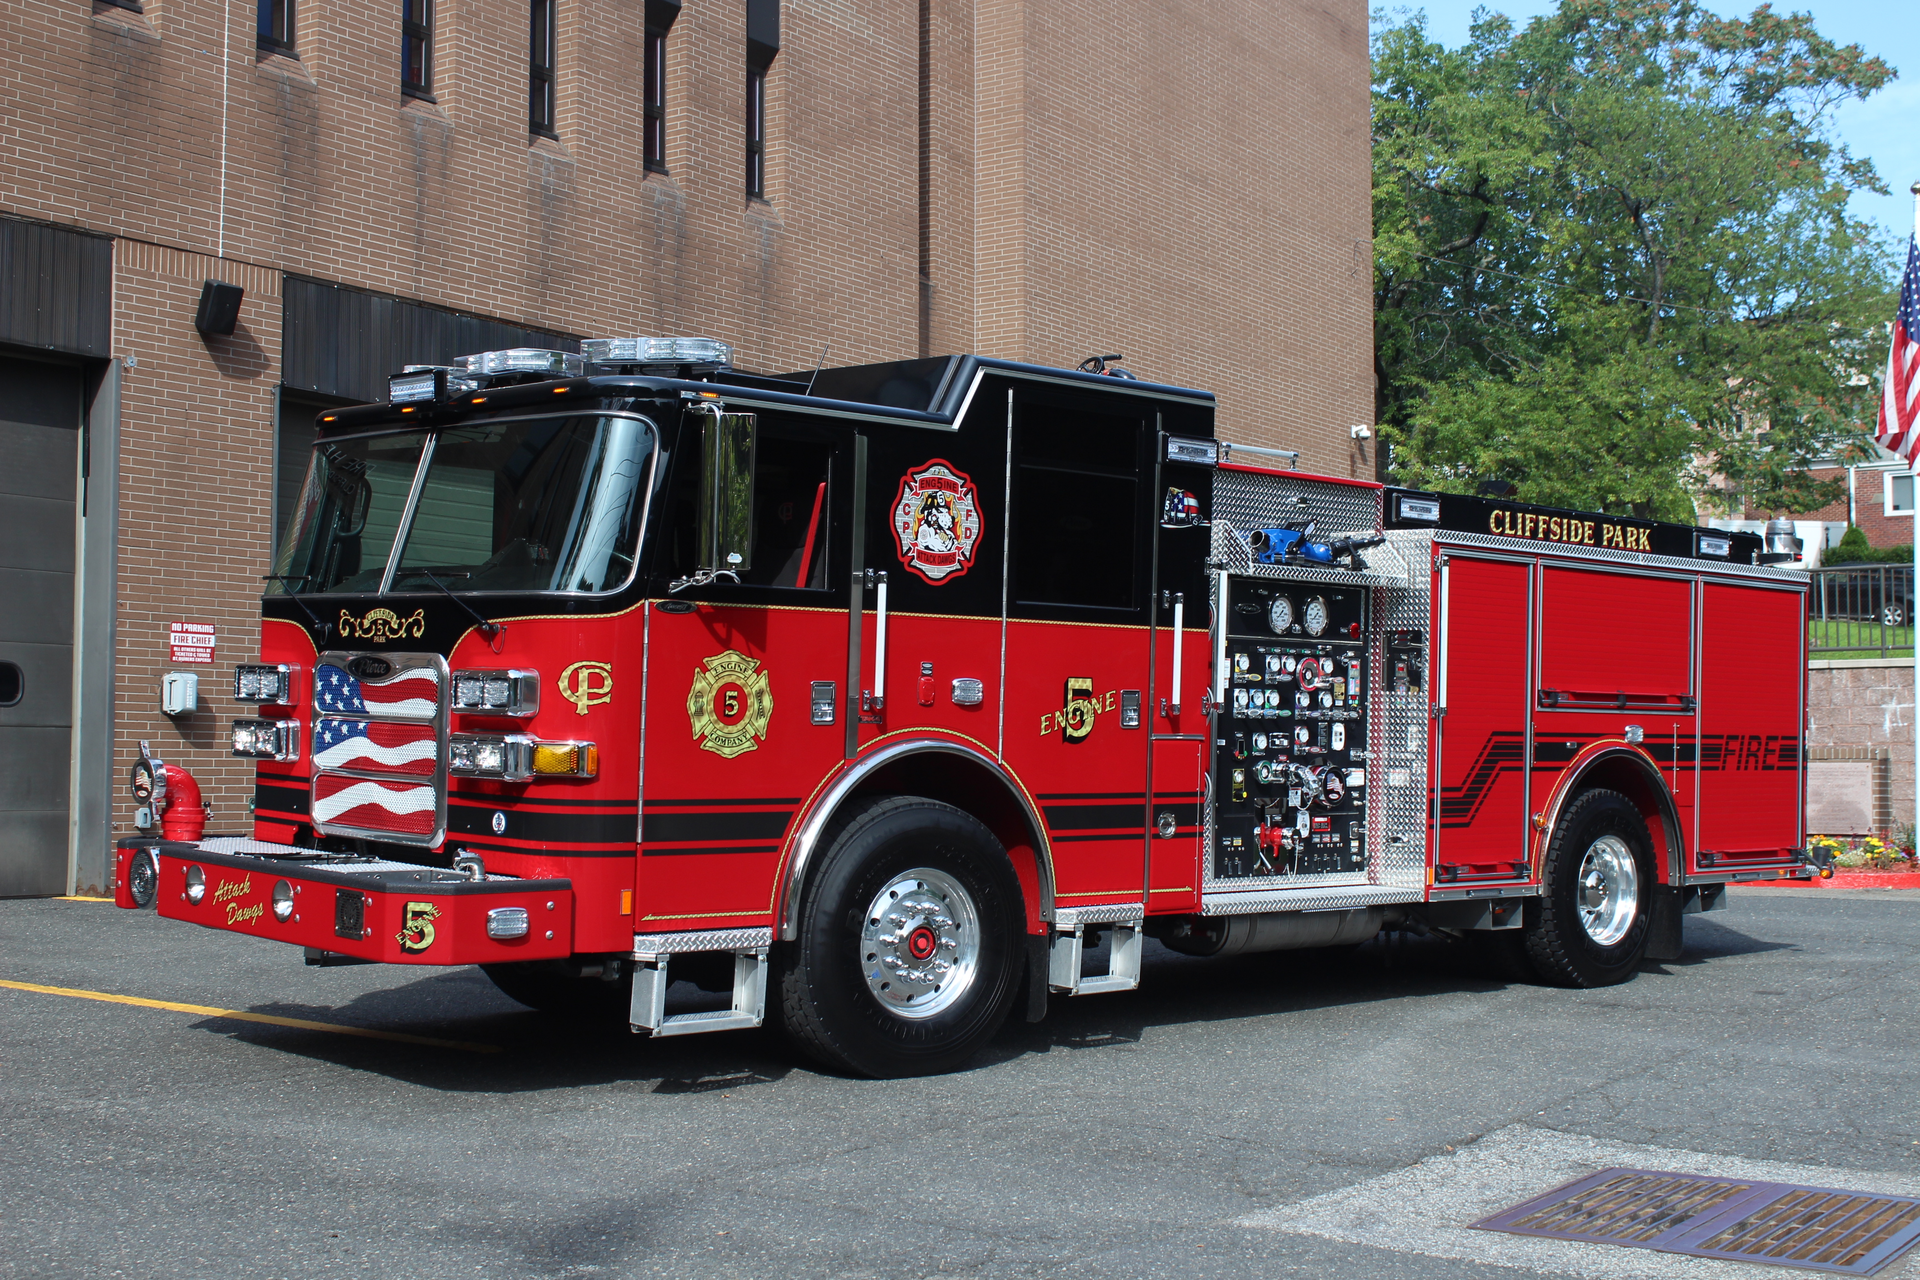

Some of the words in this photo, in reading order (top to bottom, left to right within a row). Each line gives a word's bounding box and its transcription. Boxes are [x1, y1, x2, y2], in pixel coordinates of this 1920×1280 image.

[938, 493, 944, 504] 5
[902, 503, 911, 516] C
[965, 509, 973, 521] F
[902, 521, 910, 534] P
[964, 527, 973, 540] D
[1489, 509, 1596, 547] CLIFFSIDE
[1601, 523, 1652, 553] PARK
[917, 553, 937, 564] ATTACK
[937, 554, 956, 565] DAWGS
[172, 622, 182, 631] NO
[183, 623, 214, 633] PARKING
[376, 620, 384, 635] 5
[173, 635, 190, 644] FIRE
[191, 636, 212, 645] CHIEF
[373, 635, 387, 643] PARK
[359, 658, 387, 674] Pierce
[713, 662, 749, 674] ENGINE
[724, 690, 740, 718] 5
[1064, 677, 1095, 741] 5
[1040, 690, 1117, 736] ENGINE
[709, 731, 749, 746] COMPANY
[1721, 734, 1779, 771] FIRE
[212, 872, 252, 905] Attack
[226, 902, 264, 926] Dawgs
[394, 905, 443, 944] ENGINE
[403, 901, 436, 951] 5
